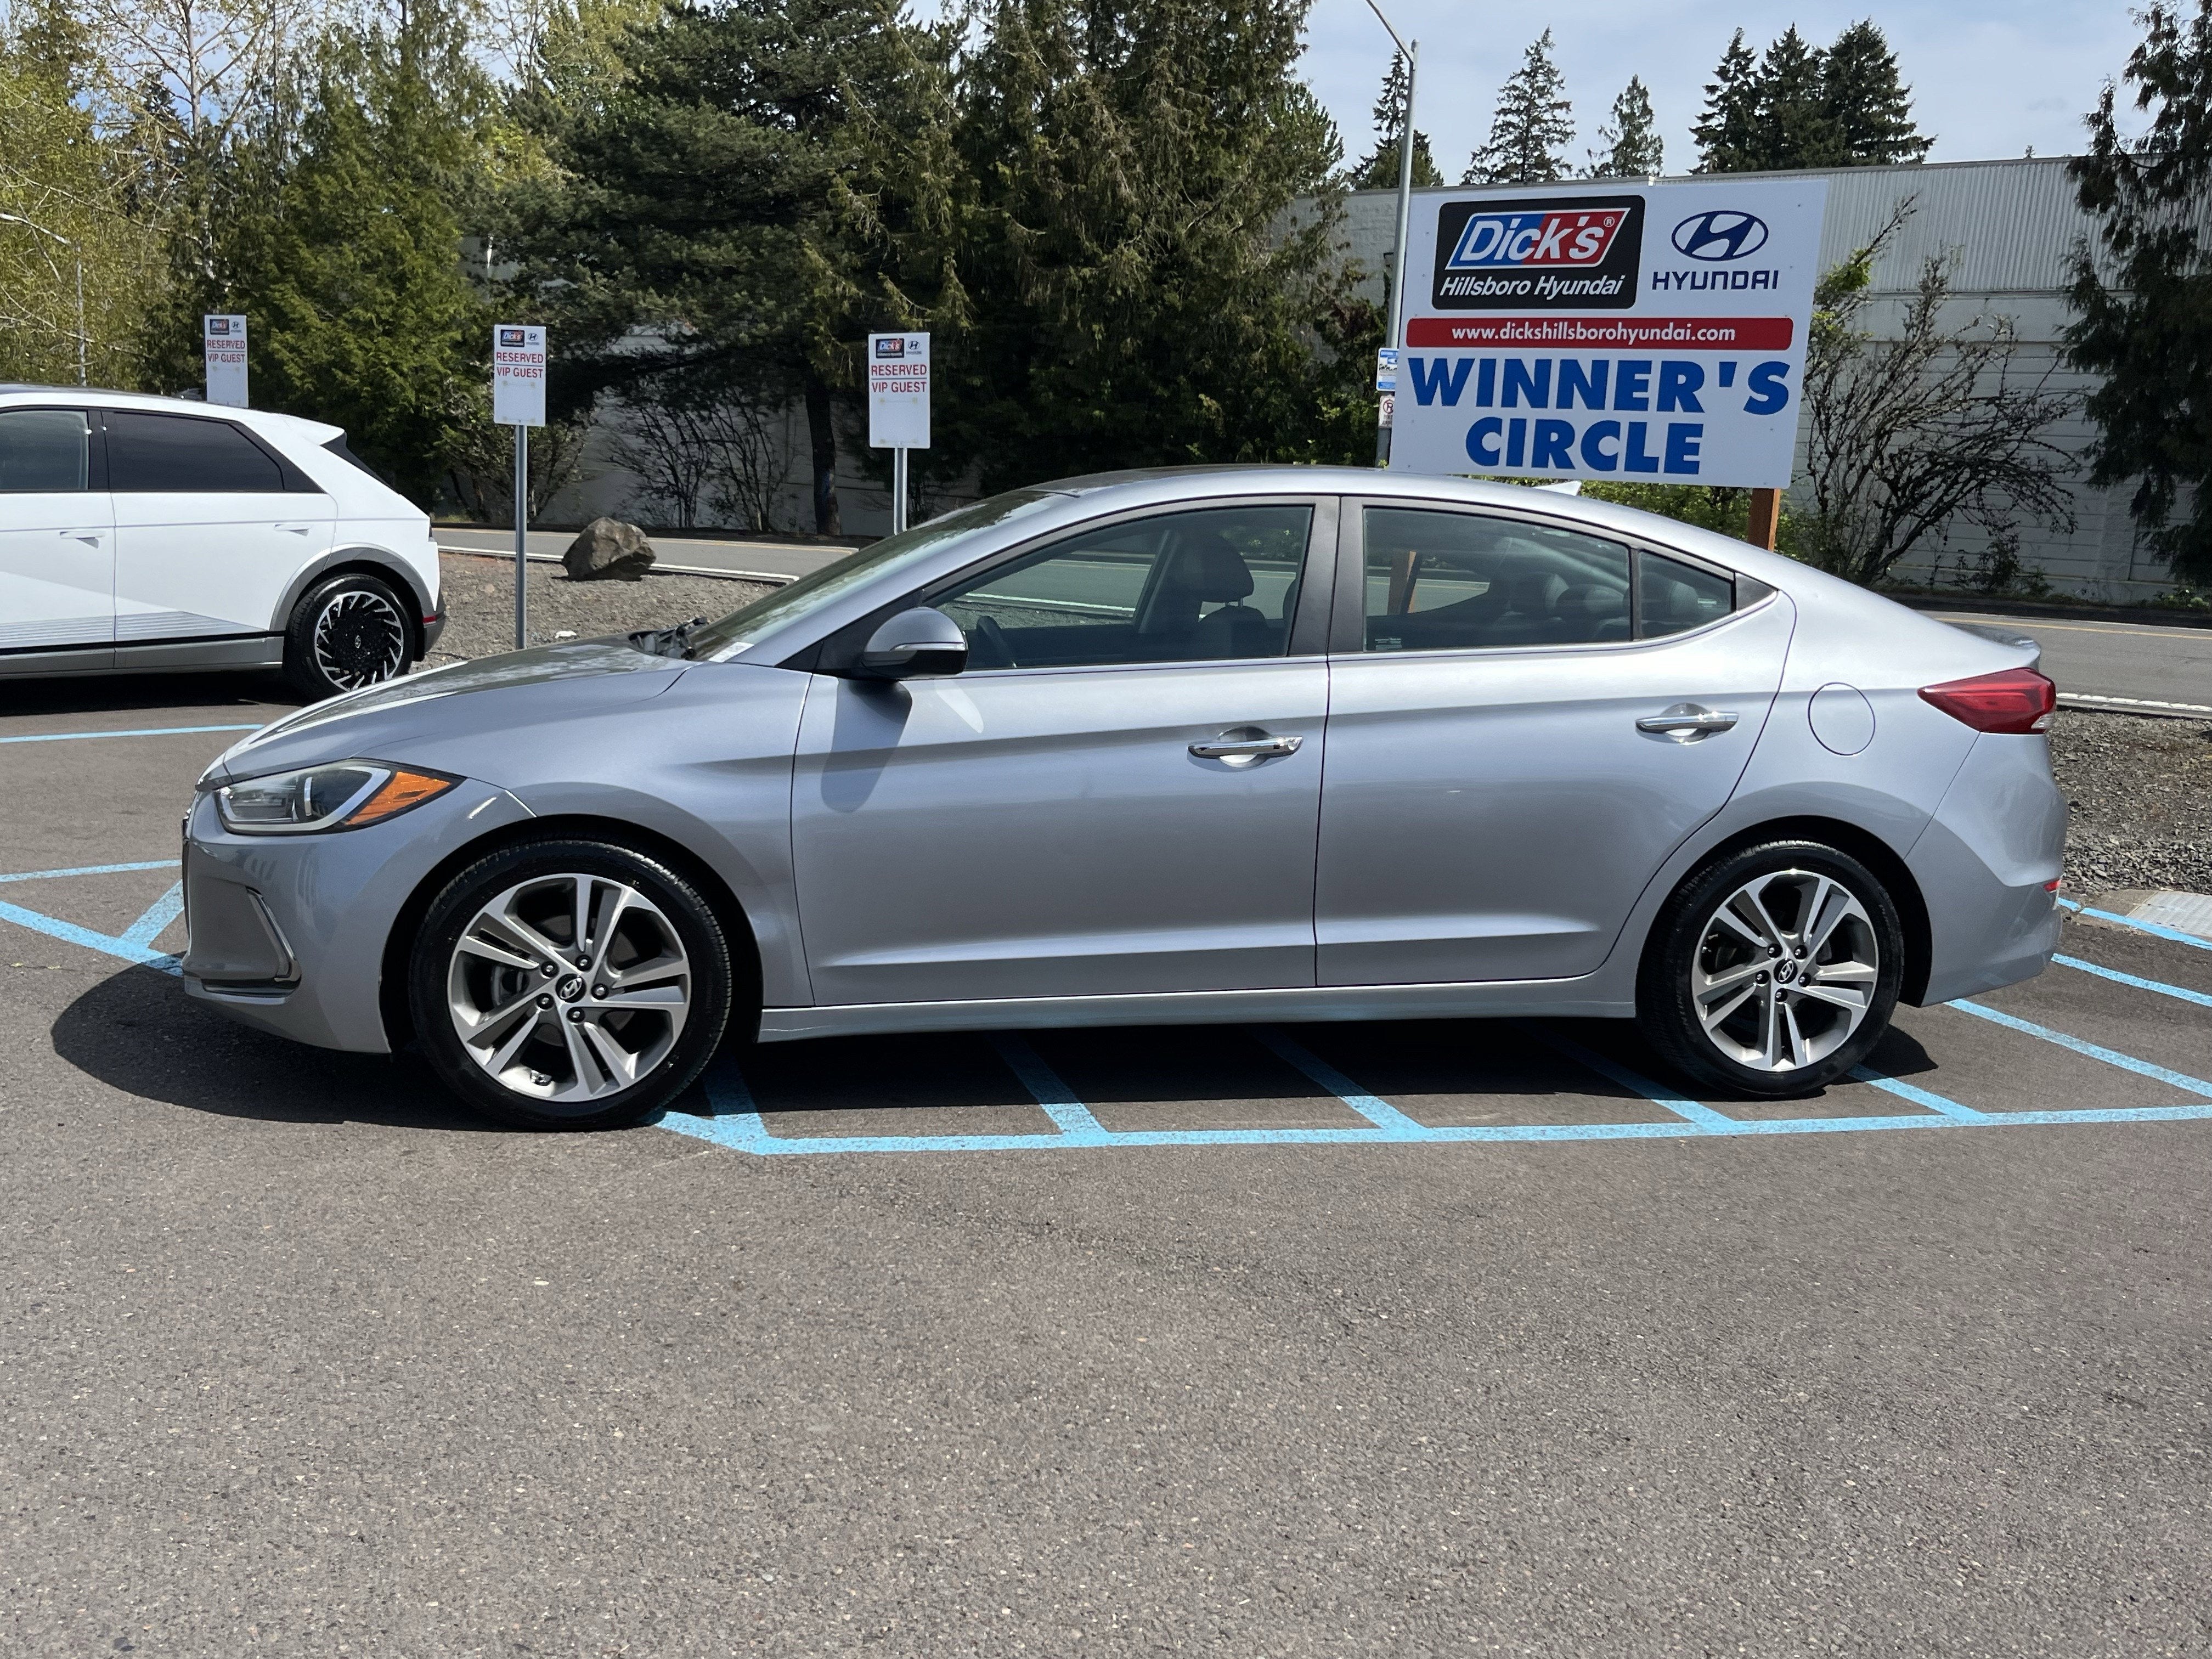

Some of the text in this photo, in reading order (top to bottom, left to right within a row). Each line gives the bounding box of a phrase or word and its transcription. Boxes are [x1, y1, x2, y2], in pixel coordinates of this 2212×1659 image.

[1652, 270, 1779, 290] HYUNDAI
[1440, 275, 1626, 300] Hillsboro Hyundai
[1452, 321, 1735, 345] www.dickshillsborohyundai.com
[207, 340, 245, 349] RESERVED
[207, 353, 245, 363] VIP GUEST
[496, 352, 544, 363] RESERVED
[496, 366, 543, 378] VIP GUEST
[871, 364, 927, 376] RESERVED
[872, 381, 927, 392] VIP GUEST
[1408, 358, 1790, 415] WINNER'S
[1465, 417, 1703, 475] CIRCLE
